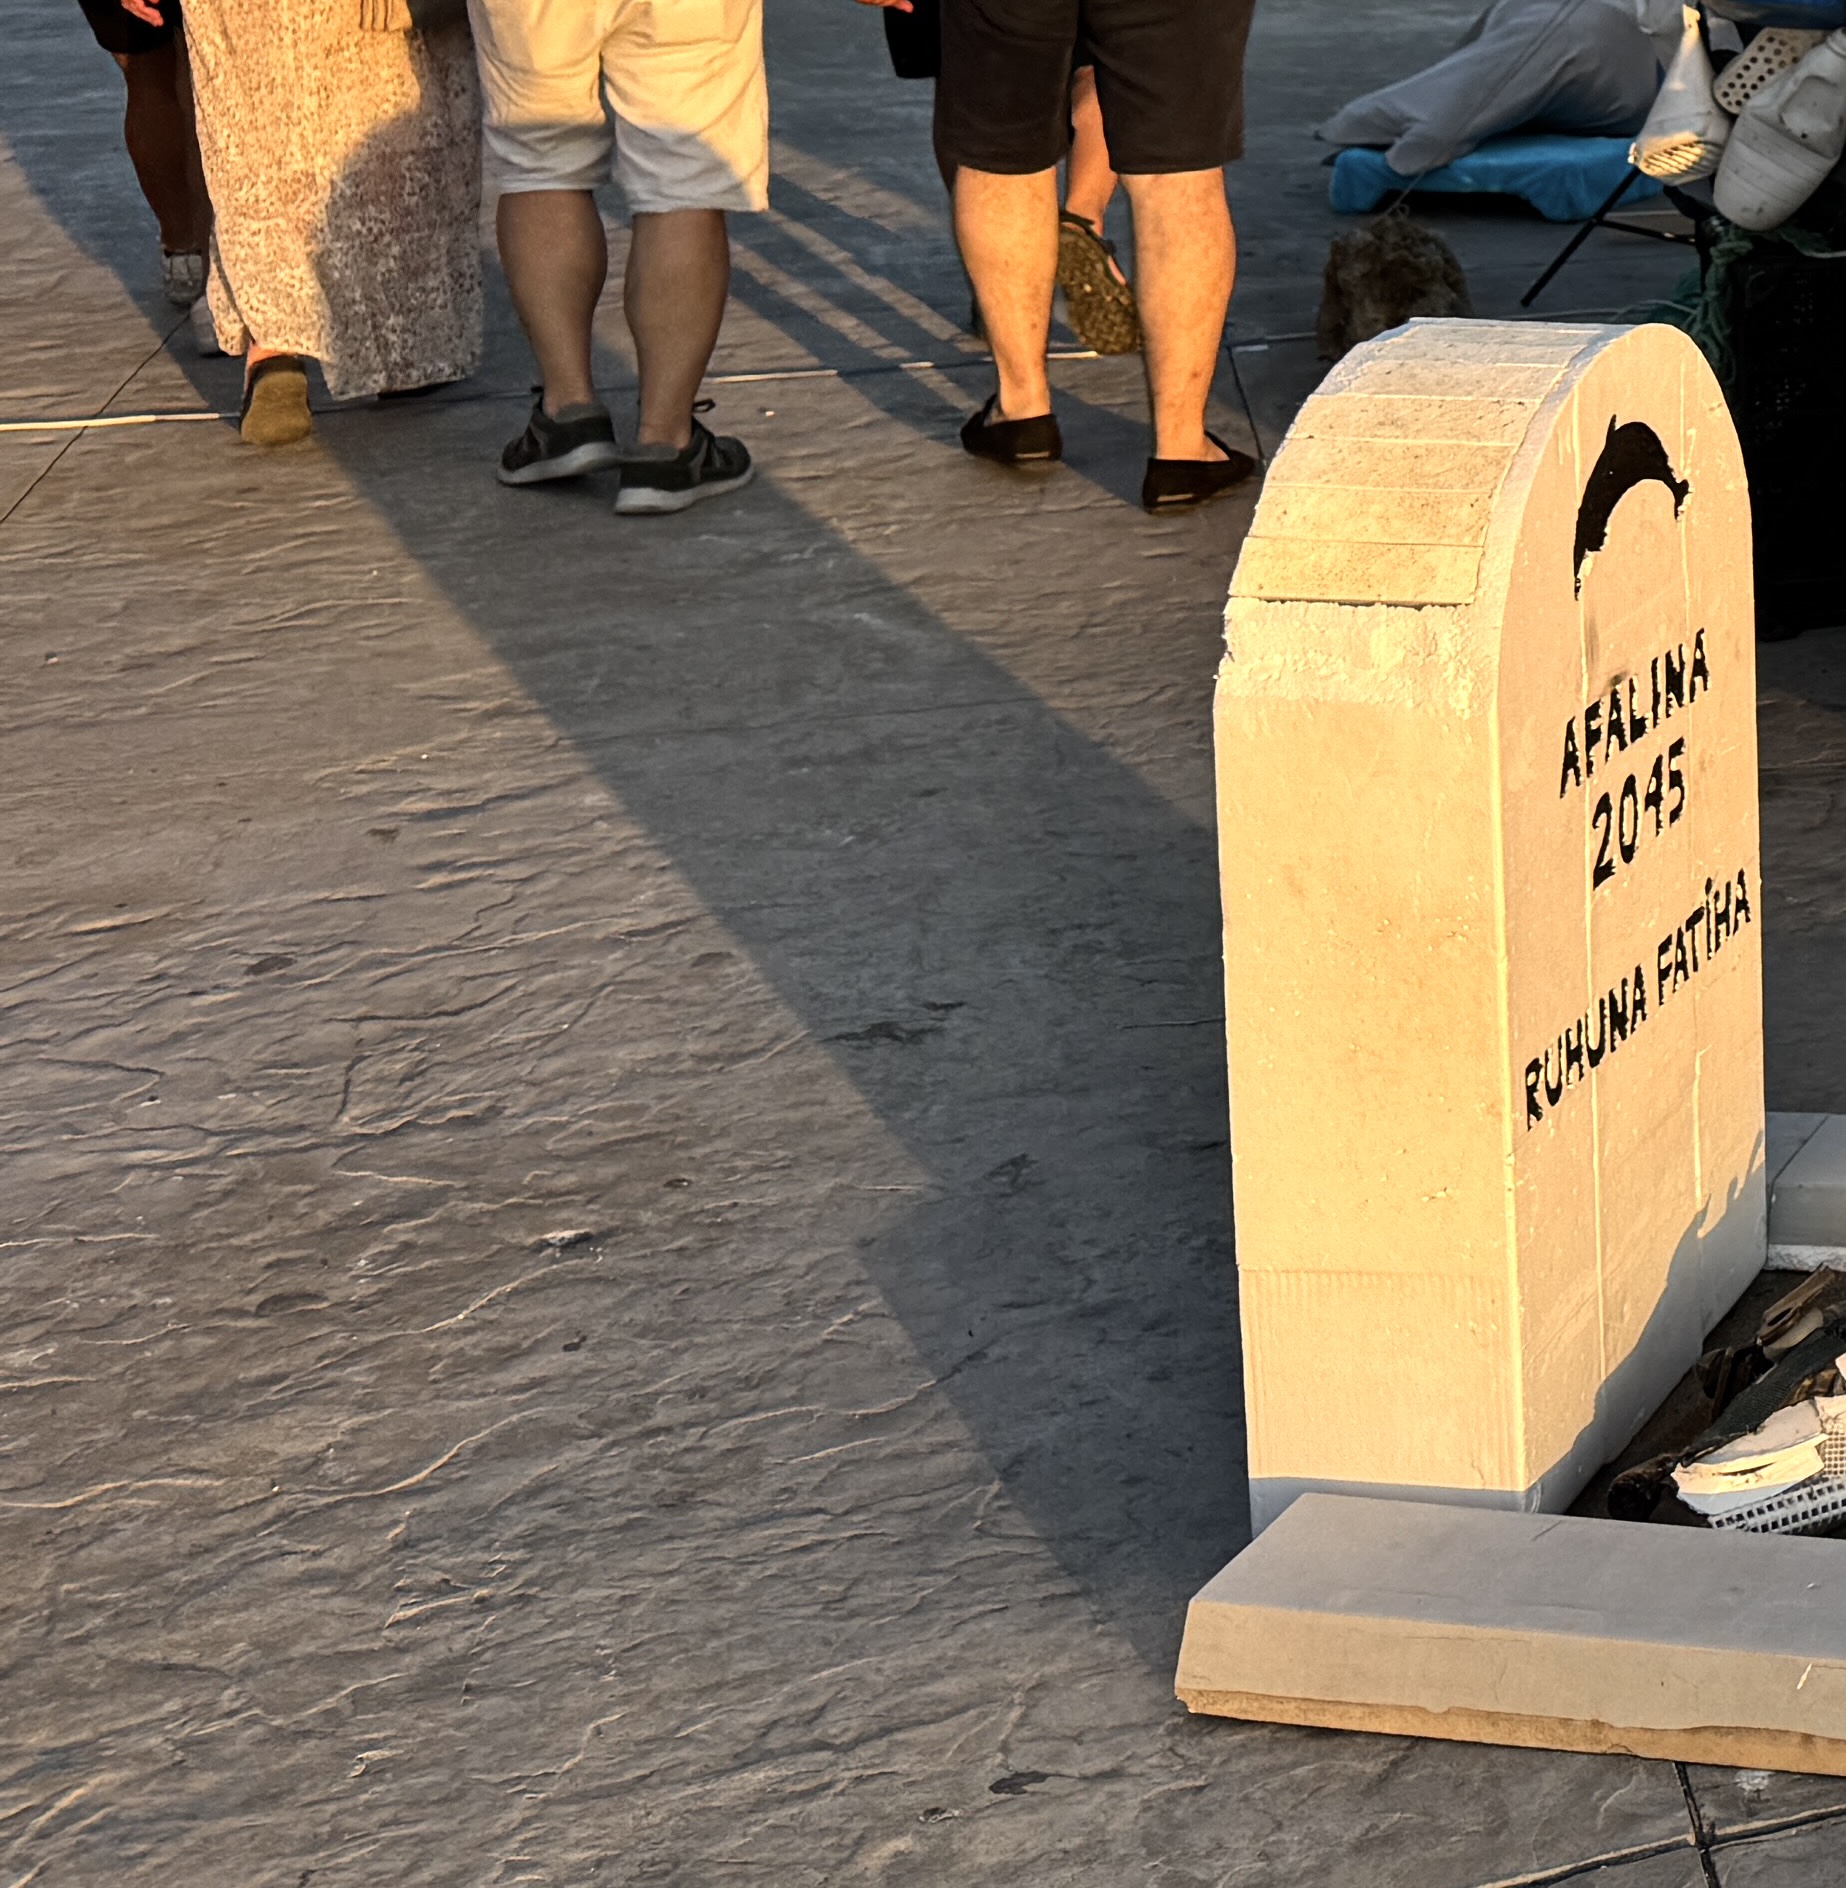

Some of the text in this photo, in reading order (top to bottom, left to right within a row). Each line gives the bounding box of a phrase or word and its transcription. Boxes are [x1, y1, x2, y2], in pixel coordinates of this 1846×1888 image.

[1559, 627, 1711, 800] AFALINA
[1591, 736, 1687, 891] 2045
[1523, 867, 1752, 1132] RUHUNA FATİHA
